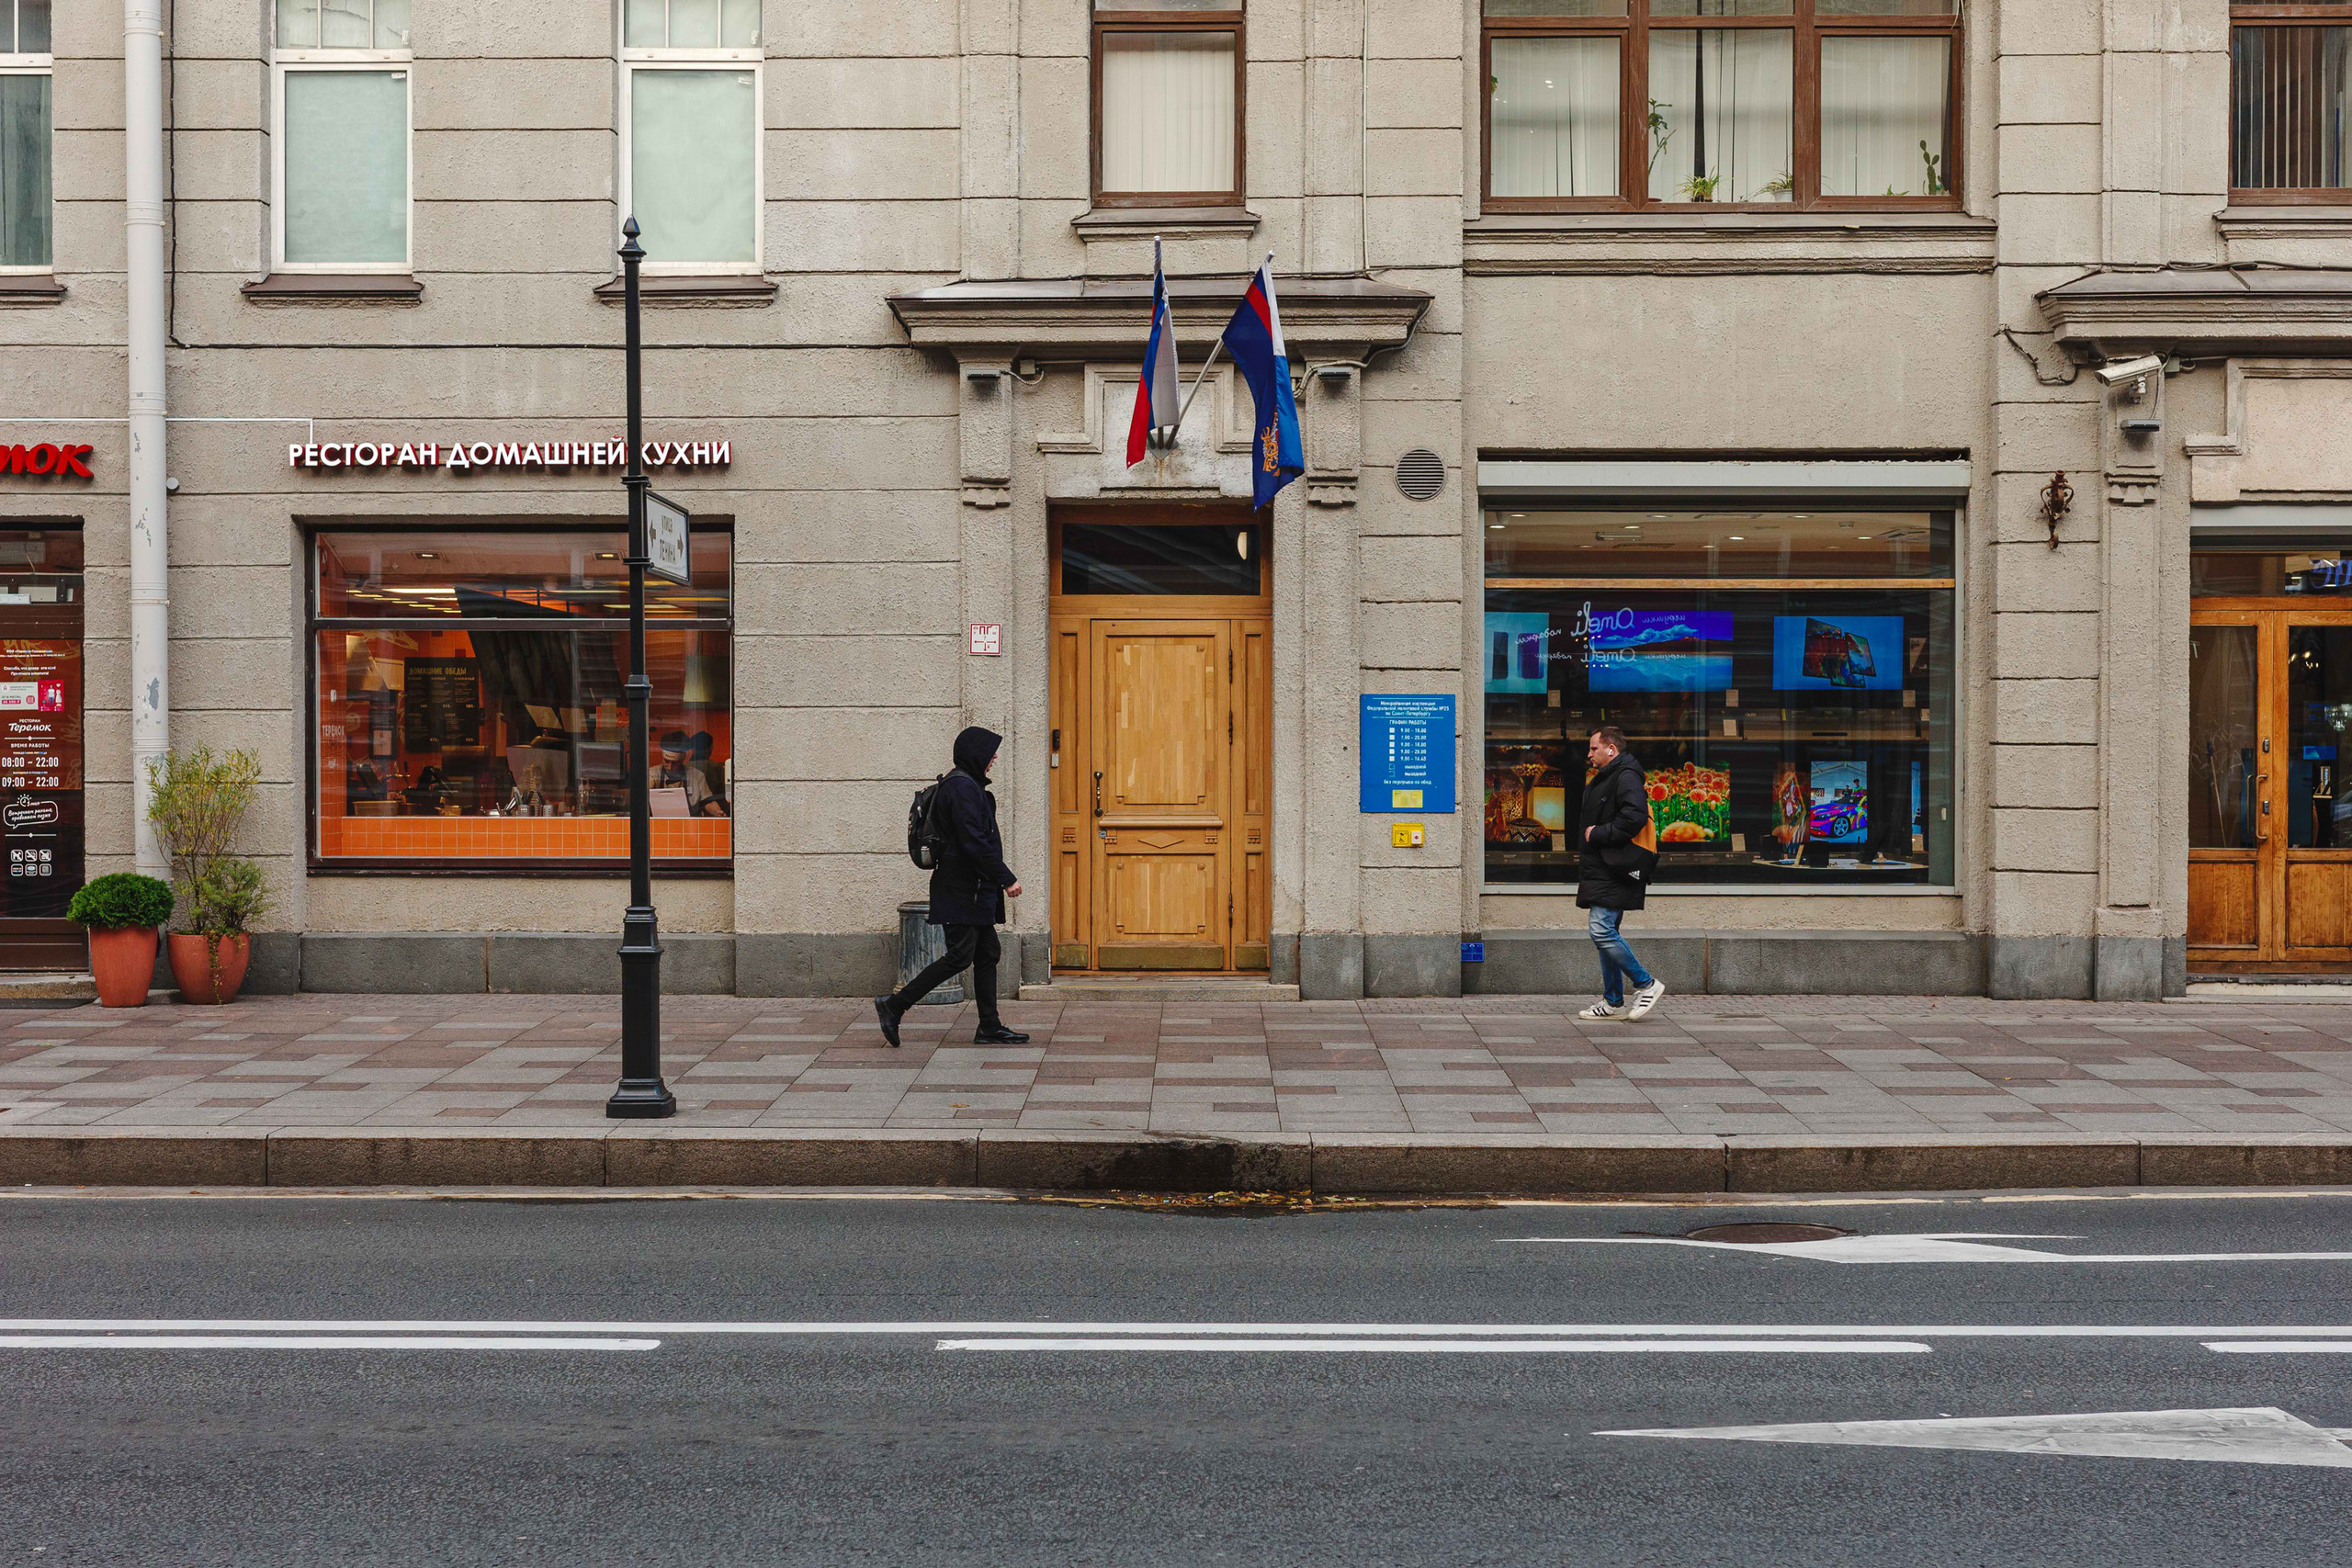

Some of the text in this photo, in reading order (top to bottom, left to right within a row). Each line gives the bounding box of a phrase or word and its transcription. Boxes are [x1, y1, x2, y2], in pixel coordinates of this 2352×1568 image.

[289, 442, 439, 468] РЕСТОРАН
[446, 435, 627, 468] ДОМАШНЕЙ
[445, 667, 467, 675] ОБЕДЫ
[8, 723, 51, 734] Теремок
[2, 757, 25, 768] 08:00
[36, 757, 59, 768] 22:00
[2, 776, 25, 787] 09:00
[36, 776, 59, 787] 22:00
